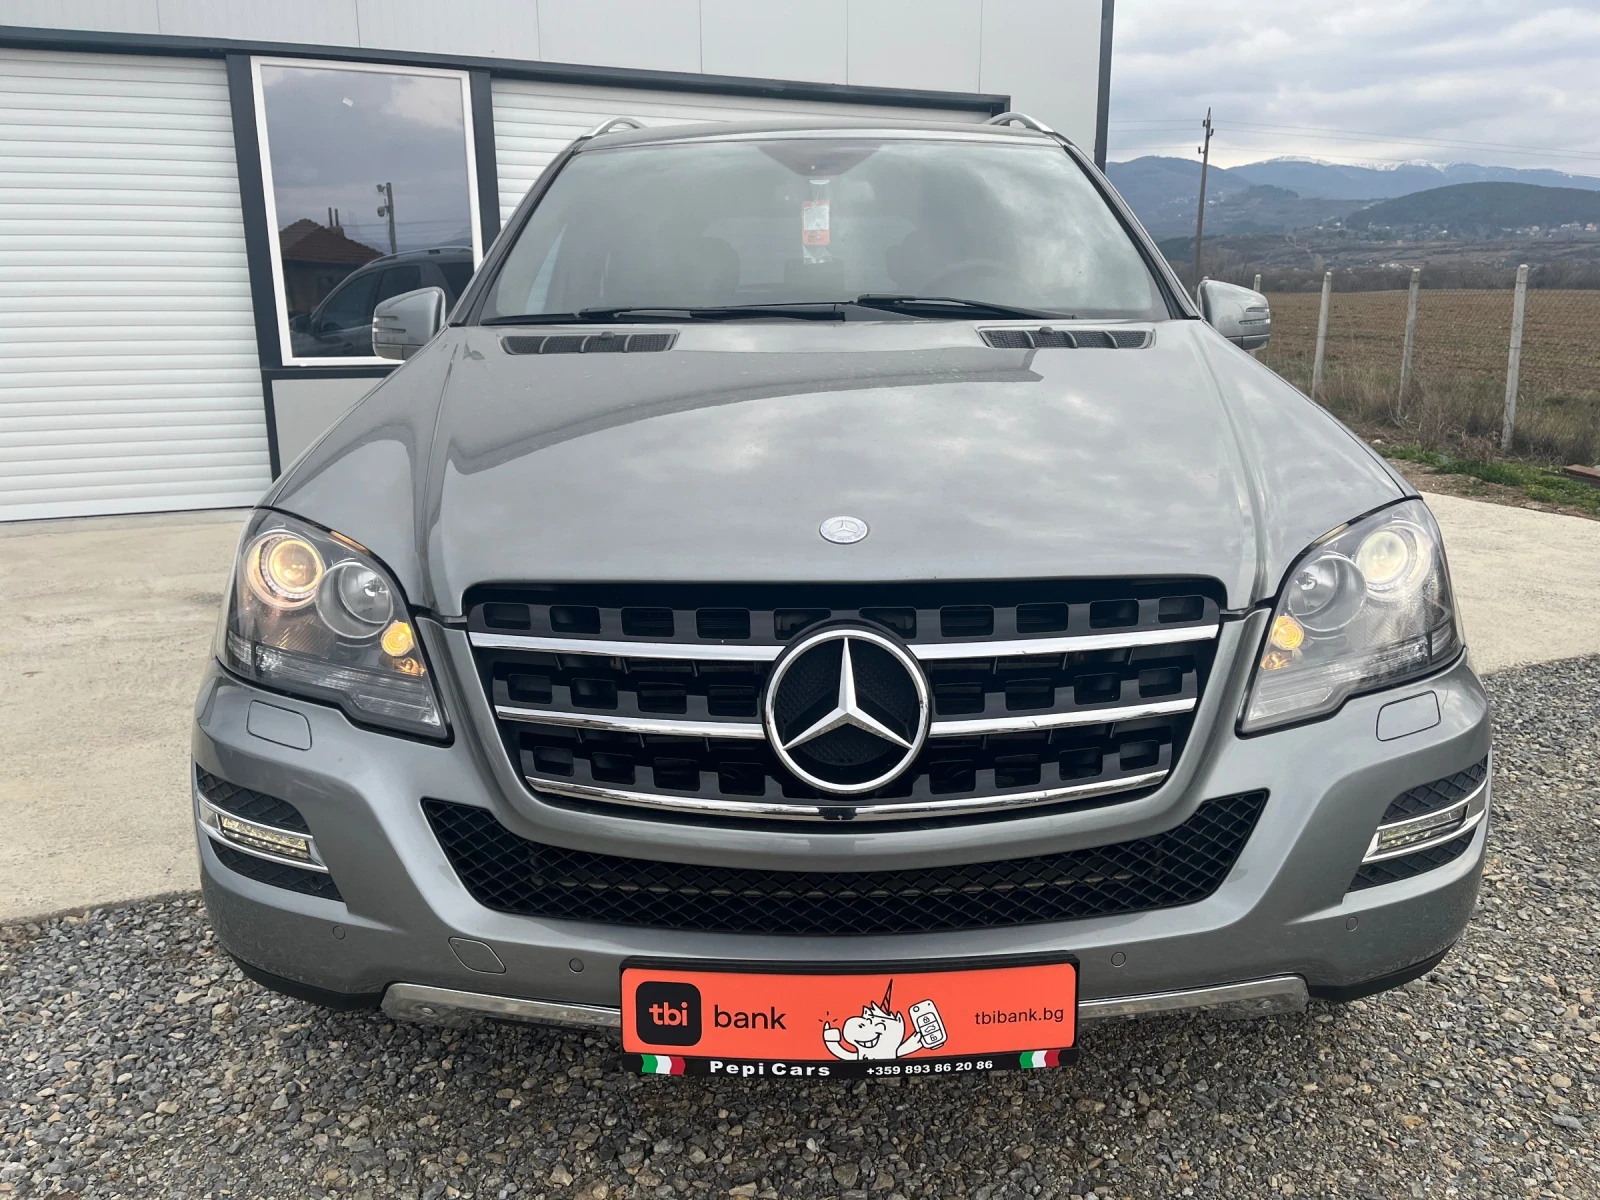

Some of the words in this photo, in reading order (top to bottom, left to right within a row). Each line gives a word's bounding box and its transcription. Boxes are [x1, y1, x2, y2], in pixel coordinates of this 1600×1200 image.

[649, 1002, 688, 1026] tbi
[714, 1004, 787, 1030] bank
[975, 1007, 1064, 1025] tbibank.bg
[710, 1060, 764, 1077] Pepi
[771, 1063, 831, 1076] Cars
[866, 1065, 900, 1075] +359
[905, 1064, 931, 1074] 893
[934, 1063, 951, 1073] 86
[955, 1062, 972, 1071] 20
[976, 1060, 993, 1070] 86
